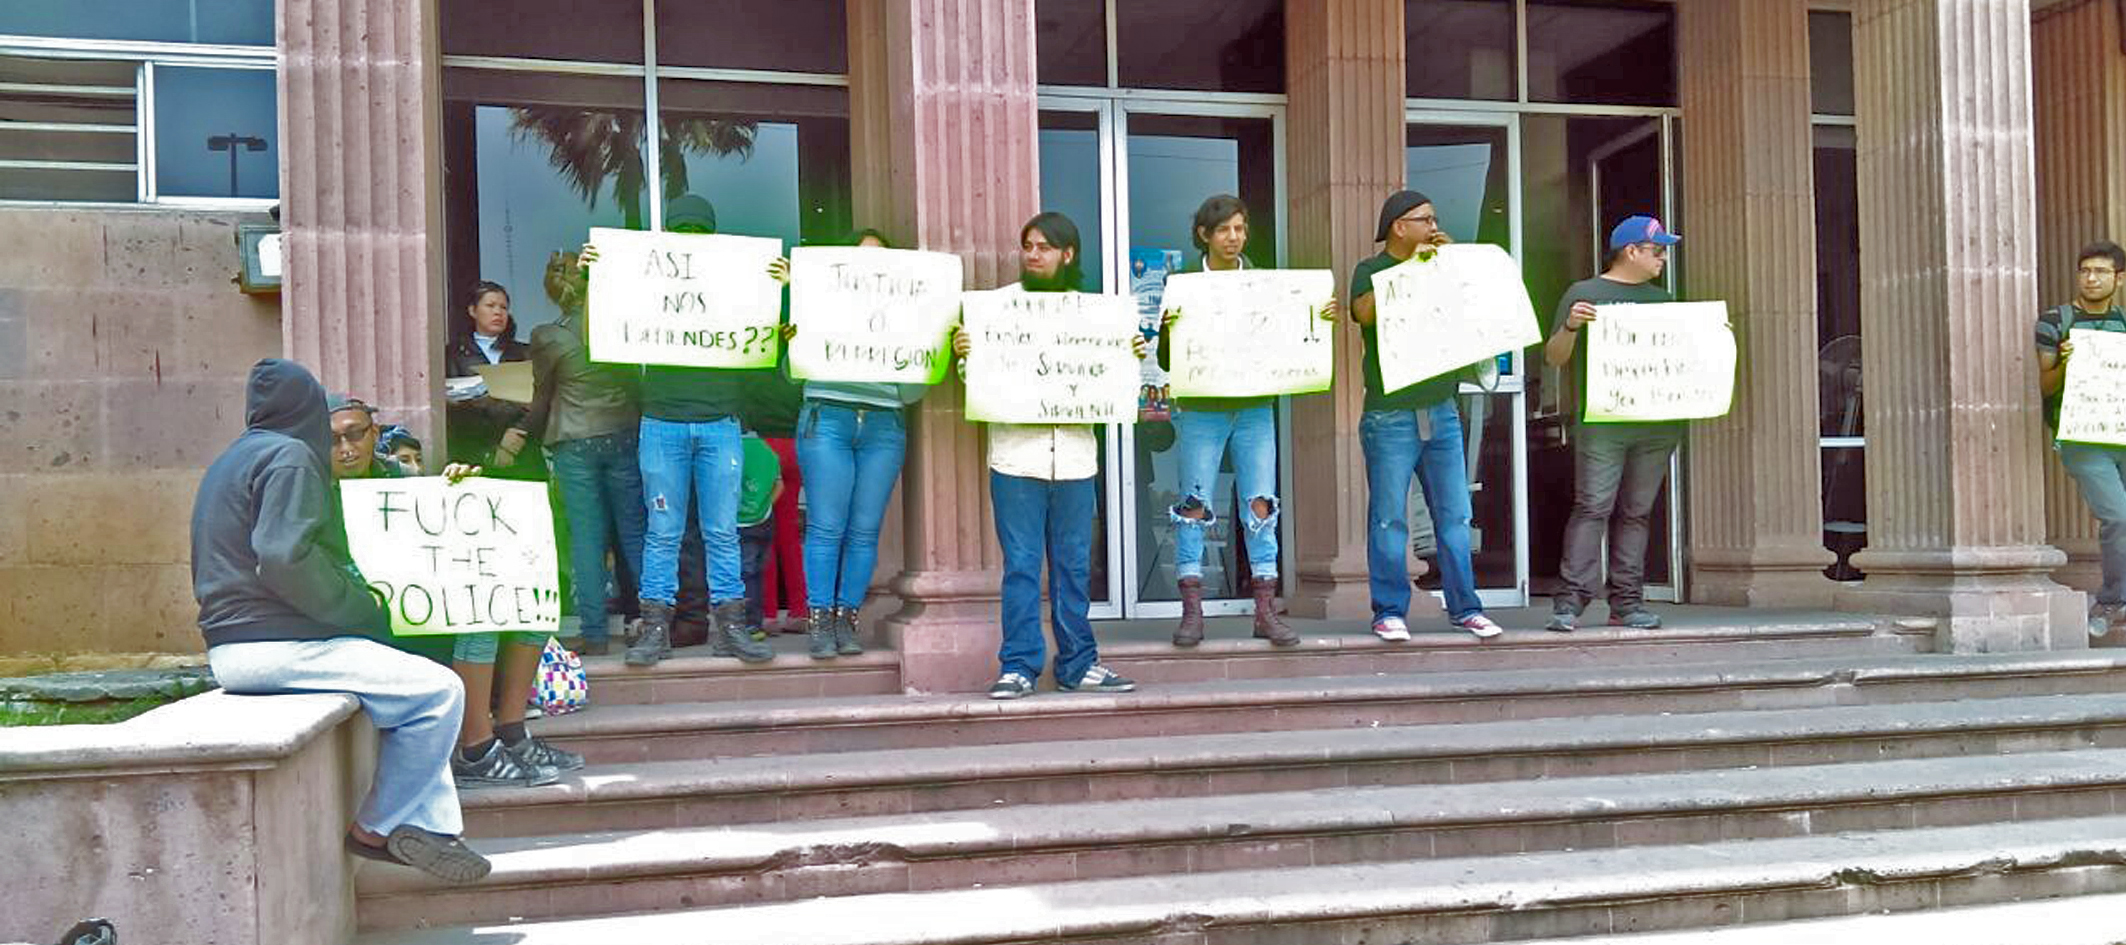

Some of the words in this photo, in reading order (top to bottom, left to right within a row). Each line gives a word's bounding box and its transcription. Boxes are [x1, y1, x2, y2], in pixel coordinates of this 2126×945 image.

[644, 248, 697, 280] ASI
[662, 291, 707, 314] NOS
[377, 491, 518, 536] FUCK
[421, 545, 497, 577] THE
